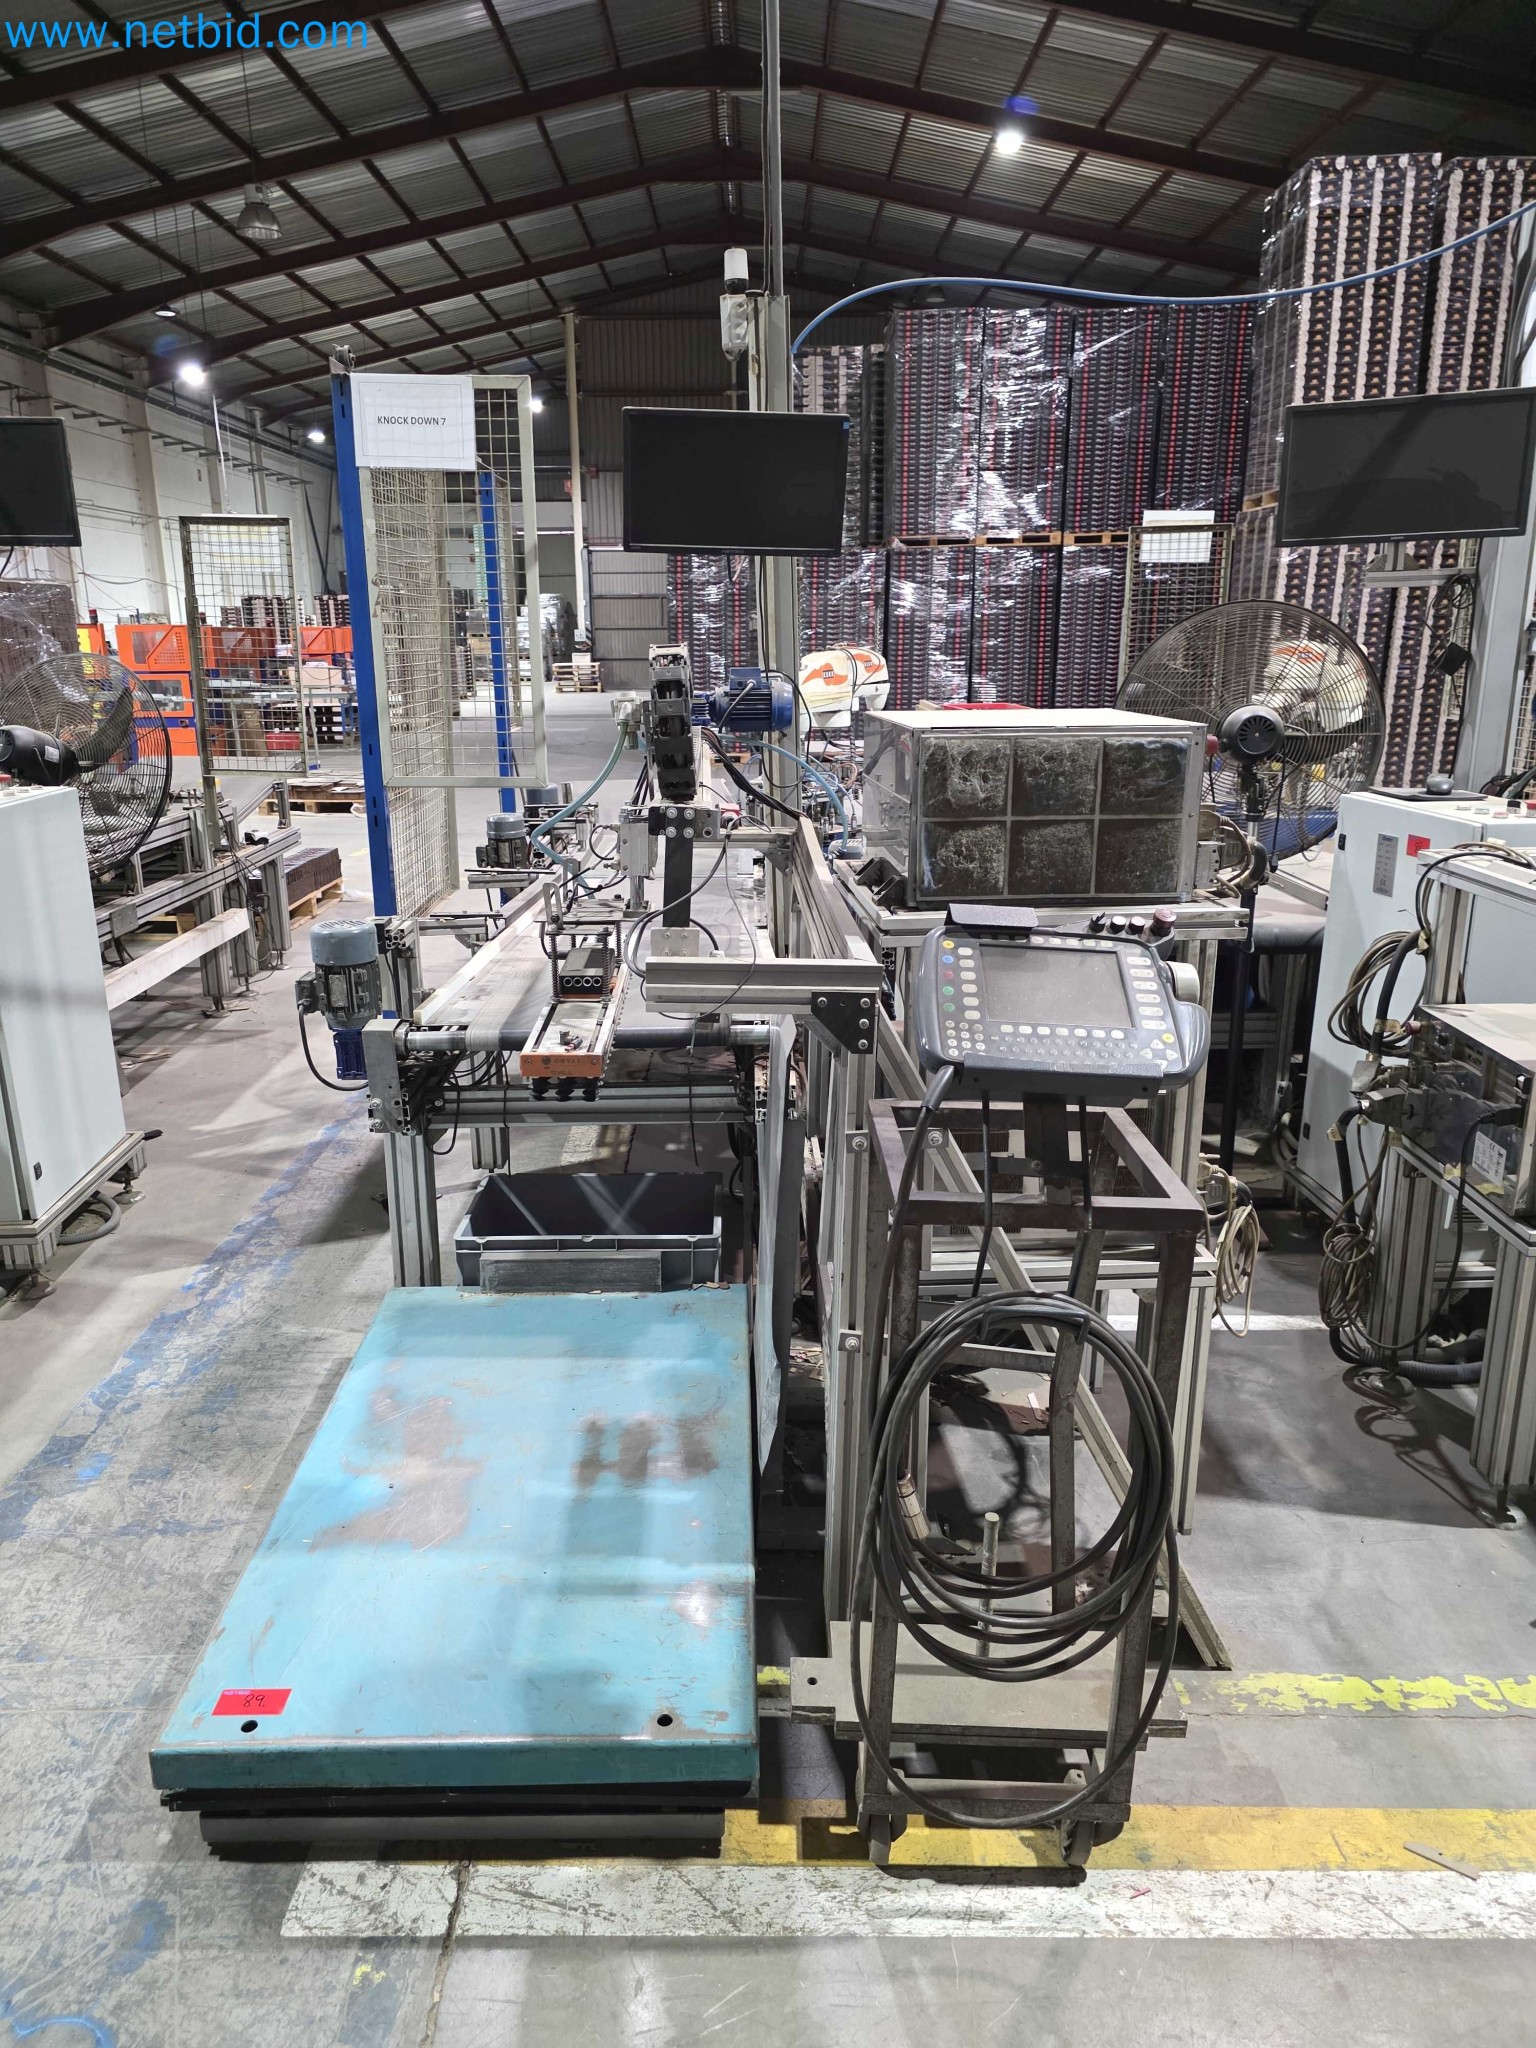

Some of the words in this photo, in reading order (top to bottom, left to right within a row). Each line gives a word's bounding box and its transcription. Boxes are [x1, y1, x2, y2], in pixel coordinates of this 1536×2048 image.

[377, 416, 409, 425] KNOCK
[410, 416, 439, 426] DOWN
[440, 417, 447, 426] 7
